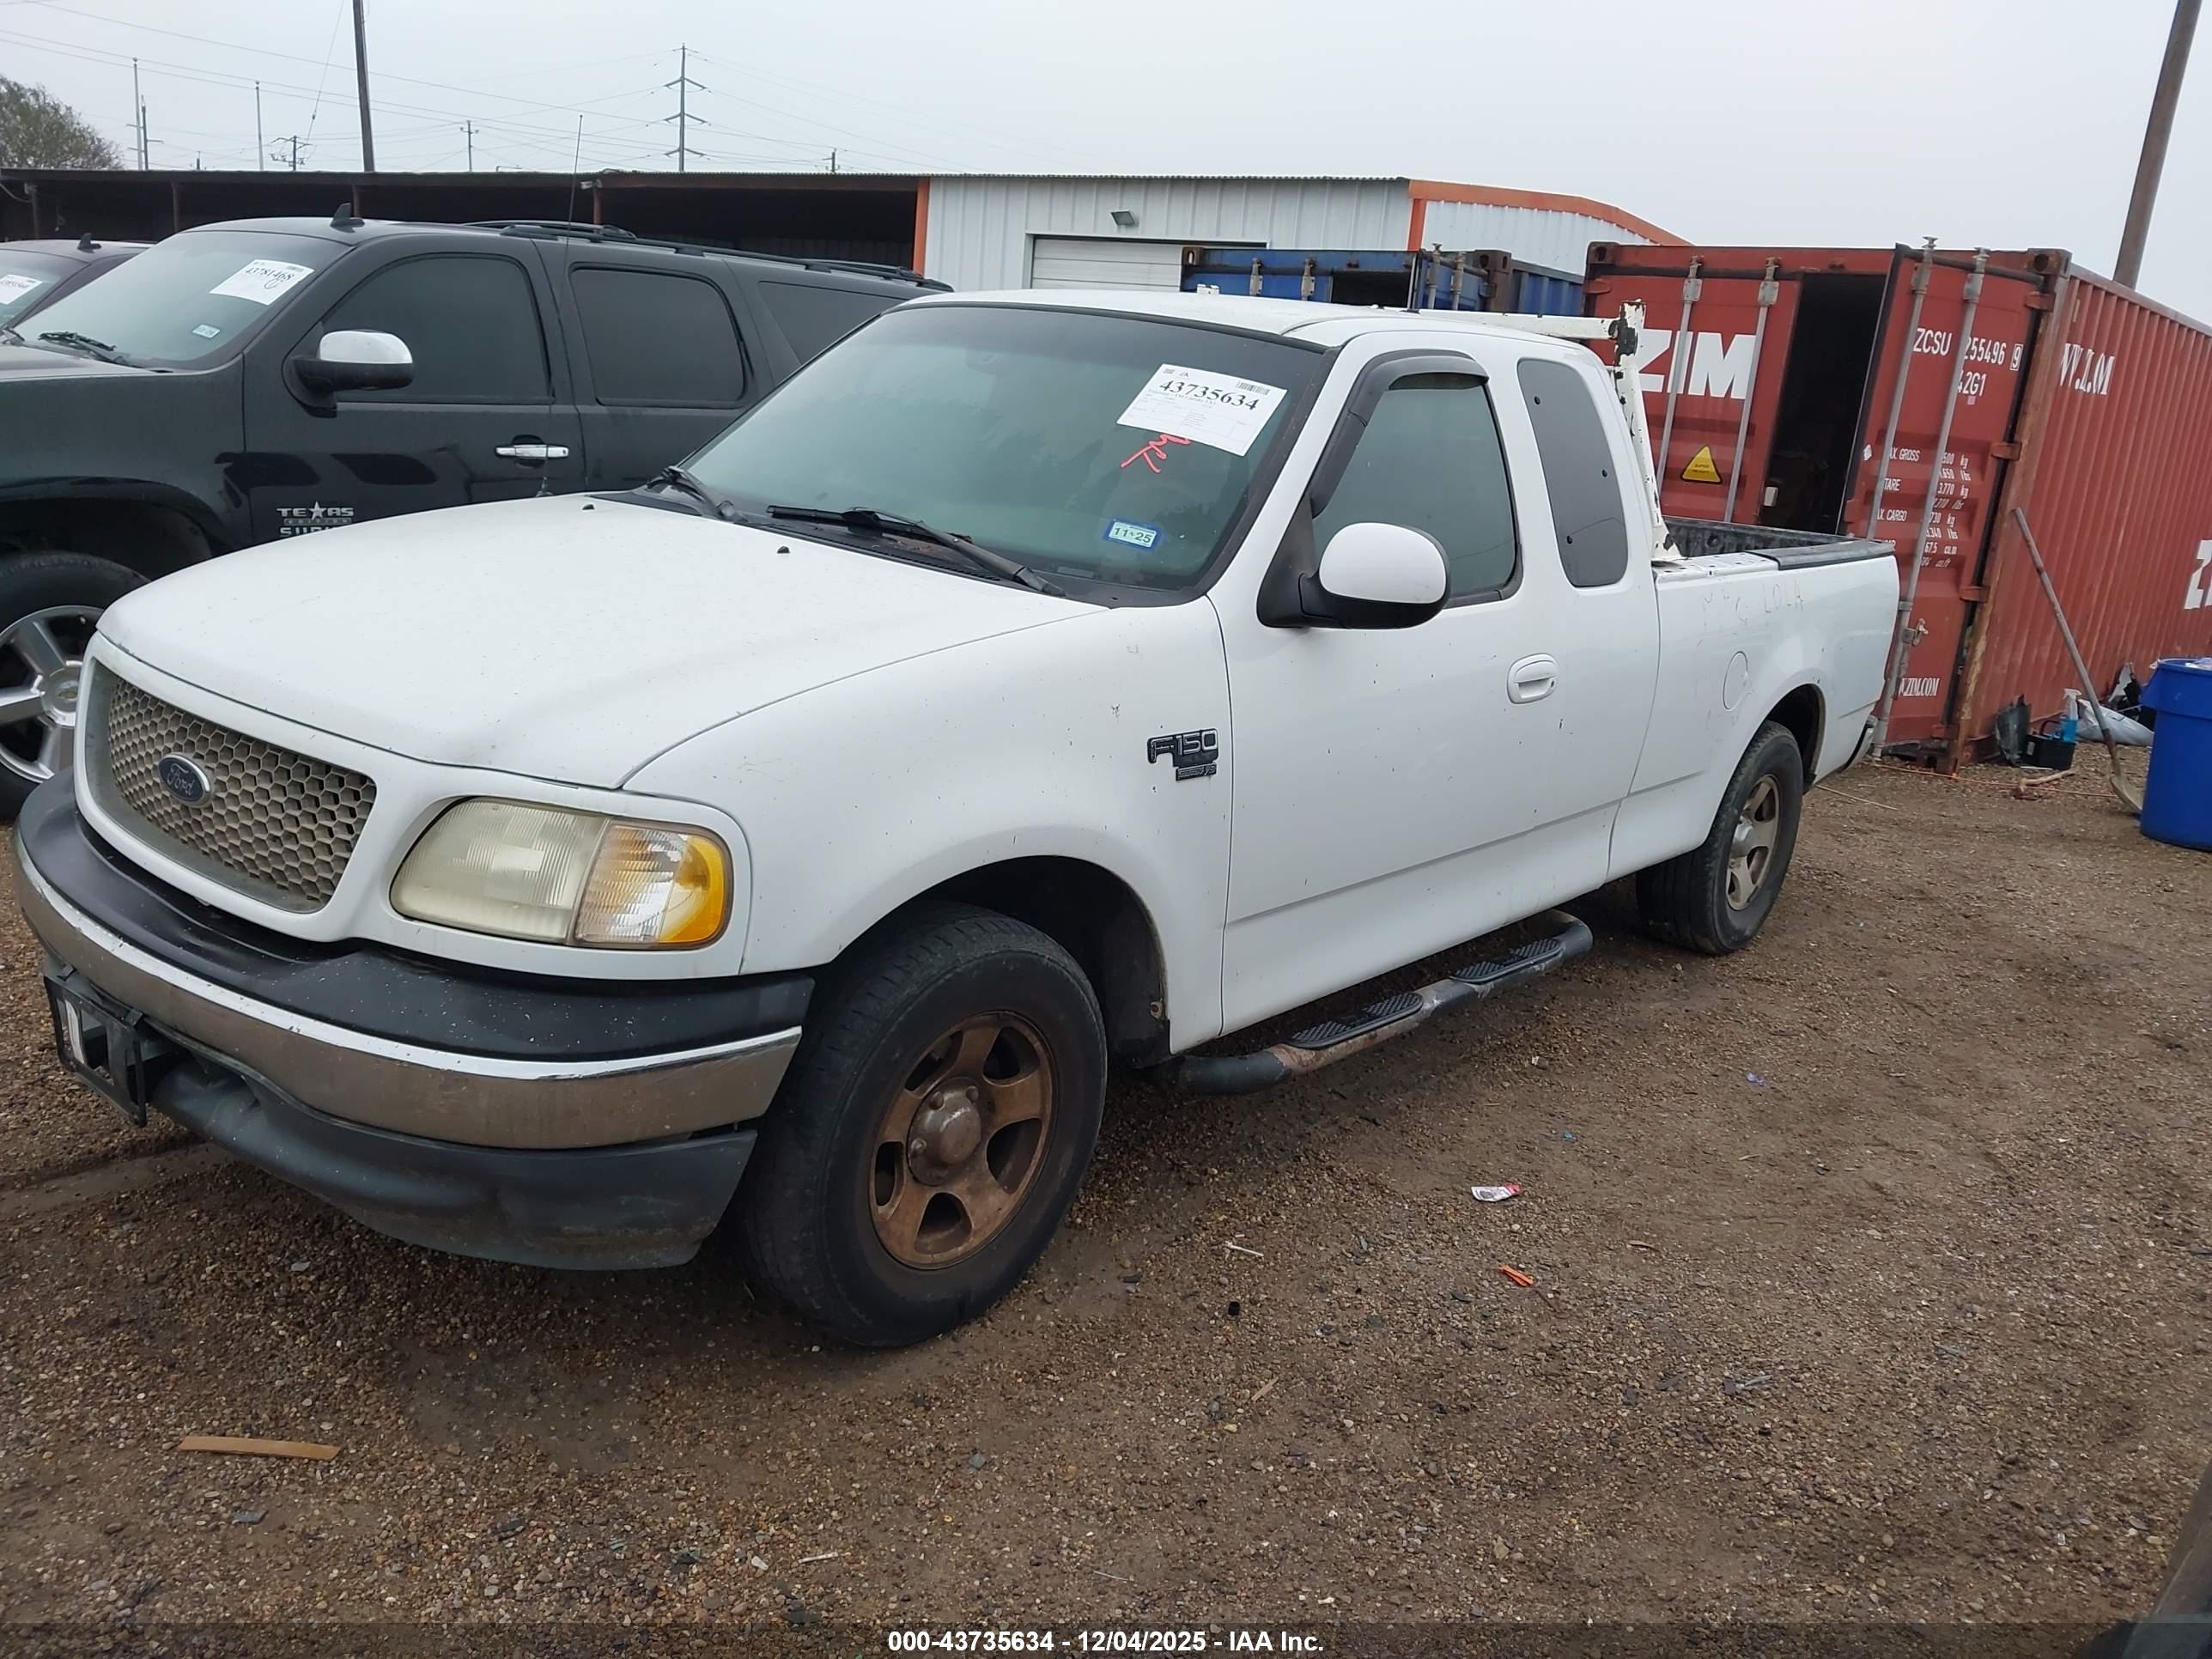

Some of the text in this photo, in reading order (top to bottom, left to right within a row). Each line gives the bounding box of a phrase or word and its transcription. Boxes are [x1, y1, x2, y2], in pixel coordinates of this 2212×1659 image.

[1637, 328, 1757, 399] ZIM
[1913, 327, 1953, 356] ZCSU
[2011, 345, 2022, 369] 9
[1160, 380, 1261, 410] 43735634
[1899, 449, 1921, 462] GROSS
[1884, 478, 1902, 491] TARE
[167, 763, 196, 796] Ford
